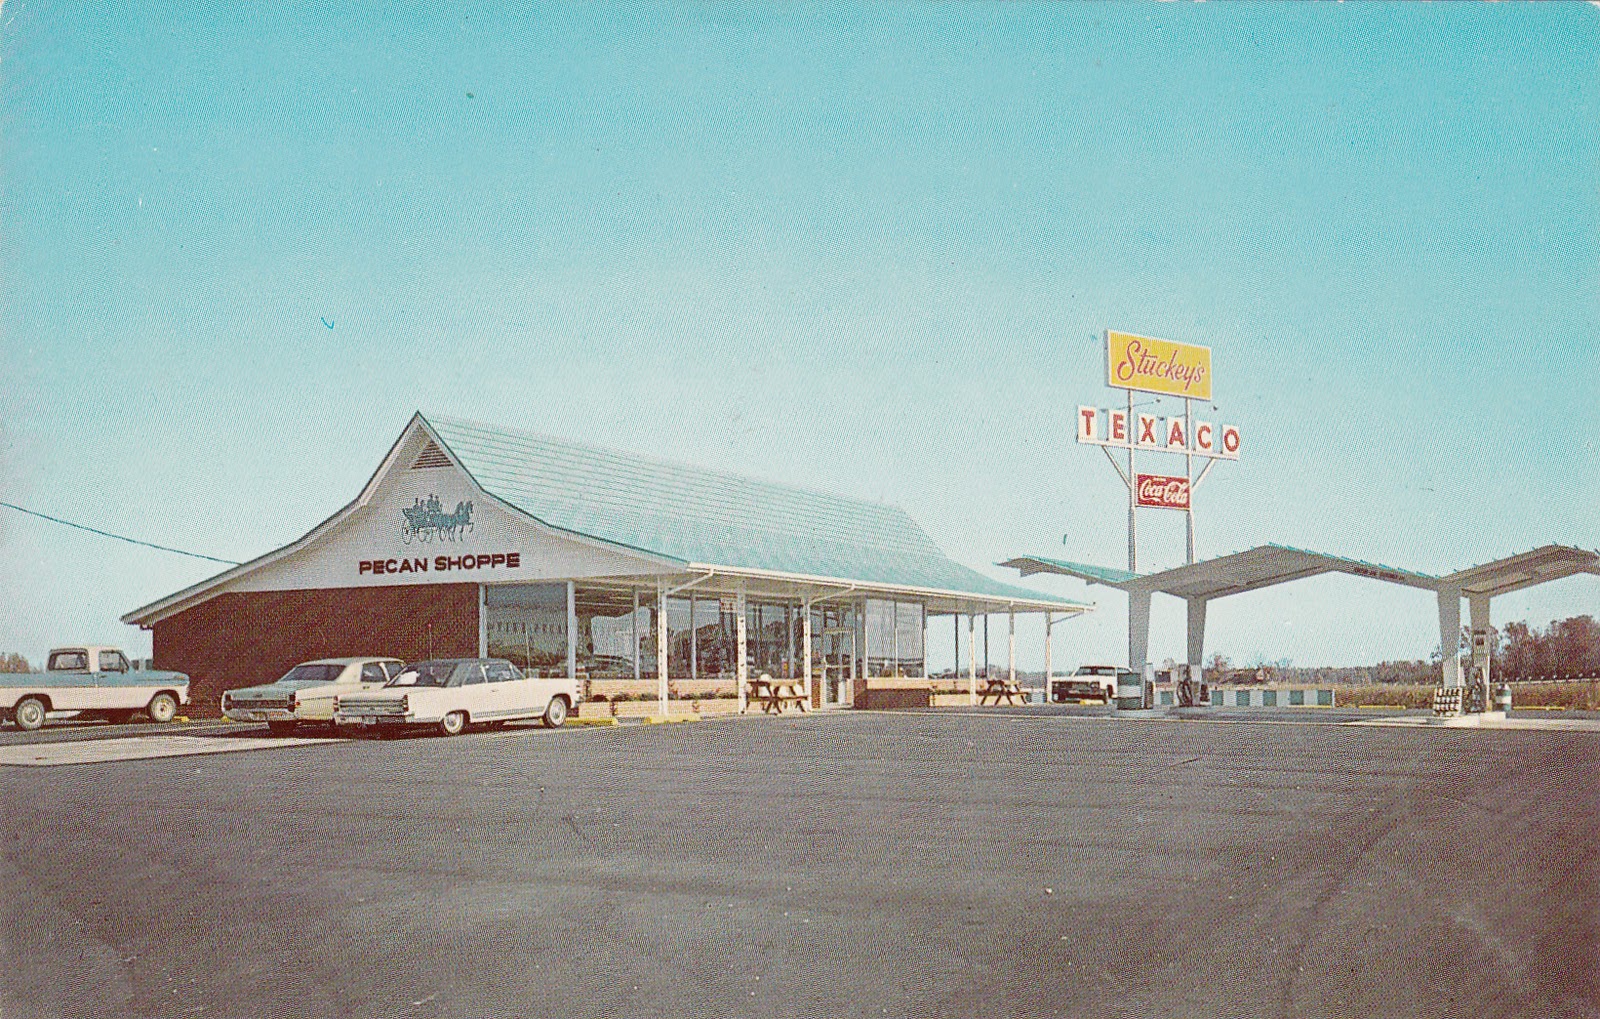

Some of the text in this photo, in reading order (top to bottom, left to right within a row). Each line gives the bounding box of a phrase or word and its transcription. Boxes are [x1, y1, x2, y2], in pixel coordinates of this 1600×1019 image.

[1116, 339, 1205, 391] Stuckey's
[1081, 410, 1240, 452] TEXACO
[359, 552, 520, 575] PECAN SHOPPE
